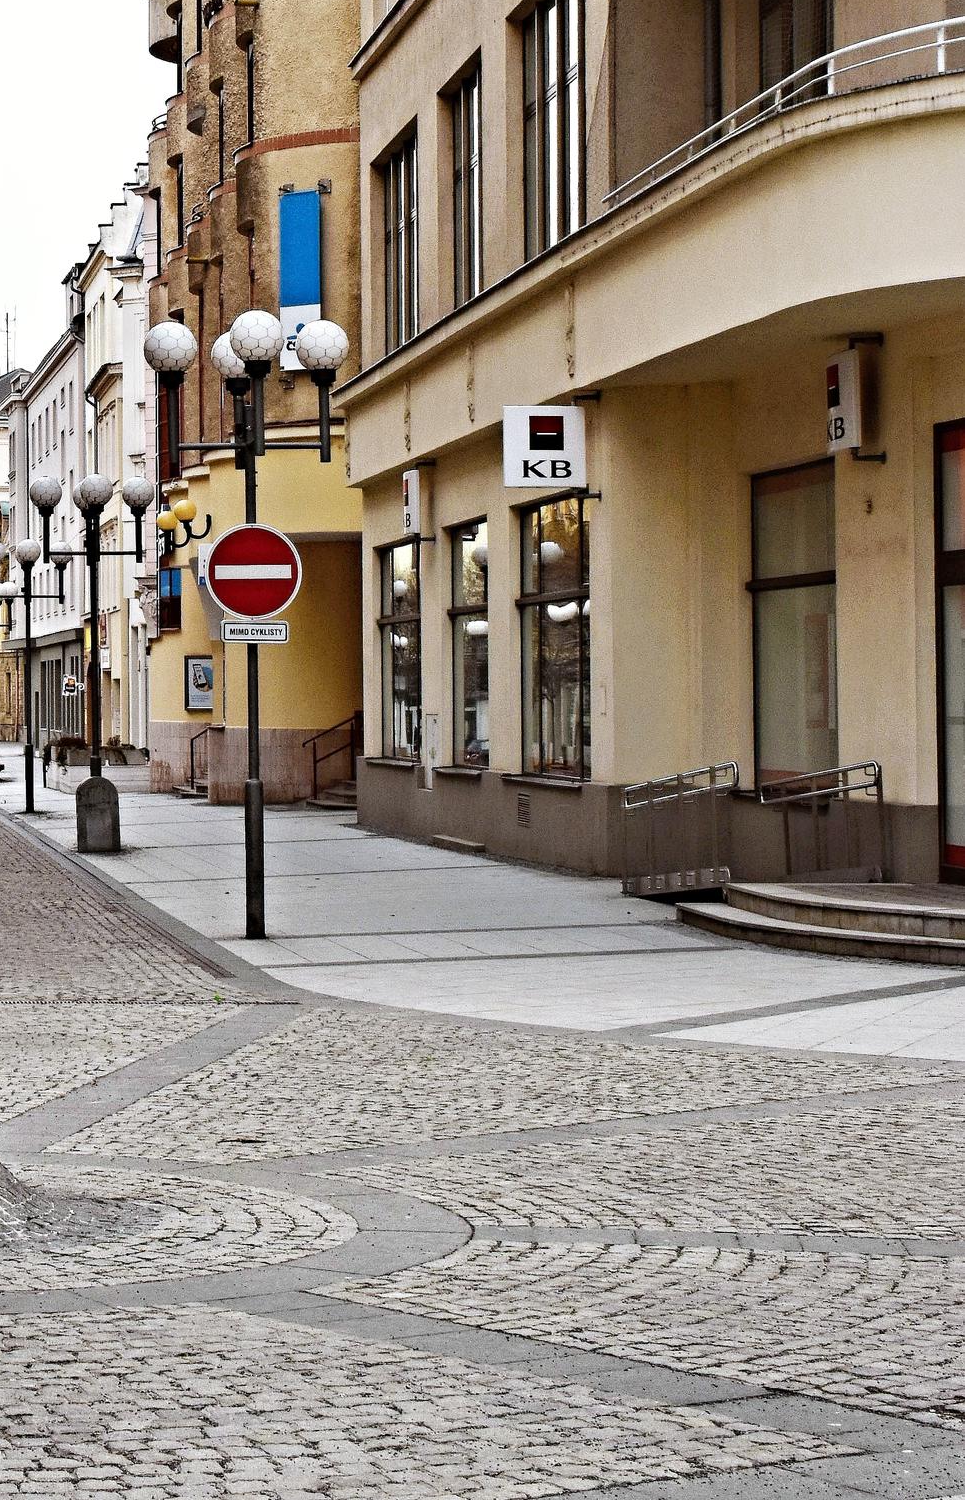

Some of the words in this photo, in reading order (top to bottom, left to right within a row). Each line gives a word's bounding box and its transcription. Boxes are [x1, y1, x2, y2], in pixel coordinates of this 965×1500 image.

[522, 459, 572, 478] KB
[229, 628, 249, 636] MIMO
[250, 628, 283, 636] CYKLISTY
